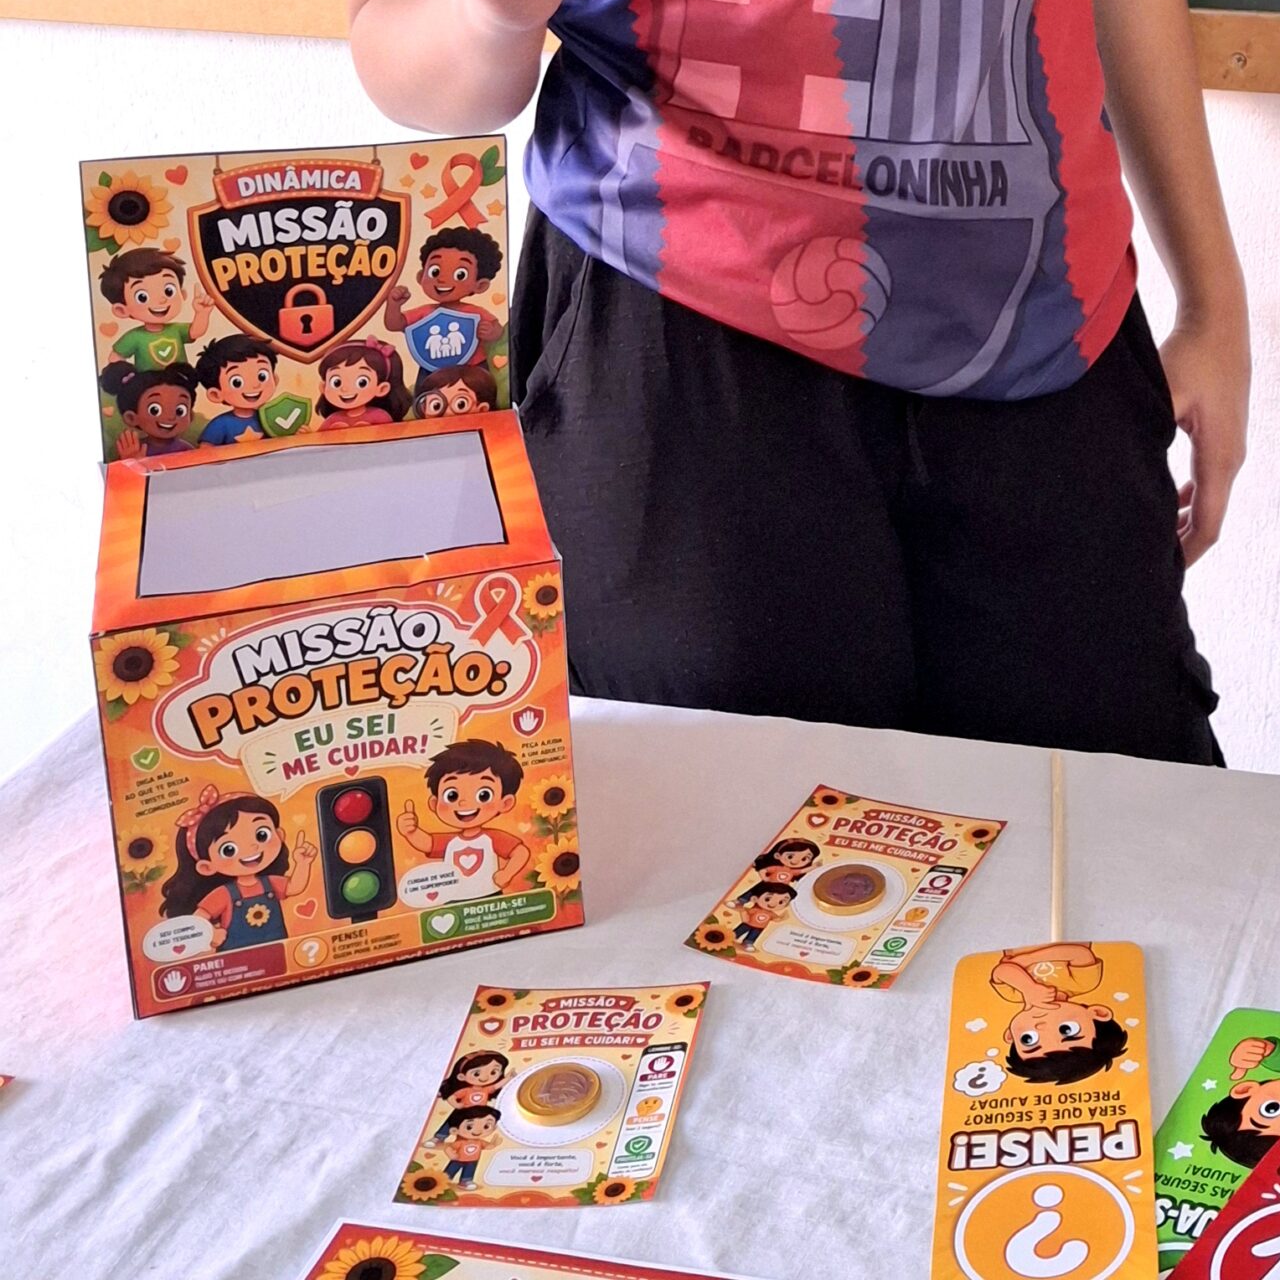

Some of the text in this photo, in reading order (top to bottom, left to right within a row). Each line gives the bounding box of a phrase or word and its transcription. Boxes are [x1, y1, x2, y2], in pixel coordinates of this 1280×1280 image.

[237, 165, 362, 198] DINÂMICA
[217, 200, 388, 253] MISSÃO
[211, 238, 397, 292] PROTEÇÃO
[231, 605, 442, 686] MISSÃO
[188, 643, 510, 750] PROTEÇÃO:
[294, 713, 396, 752] EU SEI
[282, 734, 429, 780] ME CUIDAR!
[879, 811, 926, 827] MISSÃO
[832, 817, 958, 852] PROTEÇÃO
[835, 838, 928, 860] EU SEI ME CUIDAR!
[463, 897, 527, 916] PROTEJA-SE!
[331, 928, 368, 944] PENSE!
[193, 959, 224, 973] PARE!
[560, 996, 616, 1009] MISSÃO
[512, 1008, 663, 1033] PROTEÇÃO
[520, 1035, 634, 1048] EU SEI ME CUIDAR!
[969, 1090, 1120, 1111] PRECISO DE AJUDA?
[964, 1105, 1126, 1126] SERÁ QUE É SEGURO?
[950, 1120, 1140, 1170] PENSE!
[1184, 1163, 1242, 1184] AJUDA!
